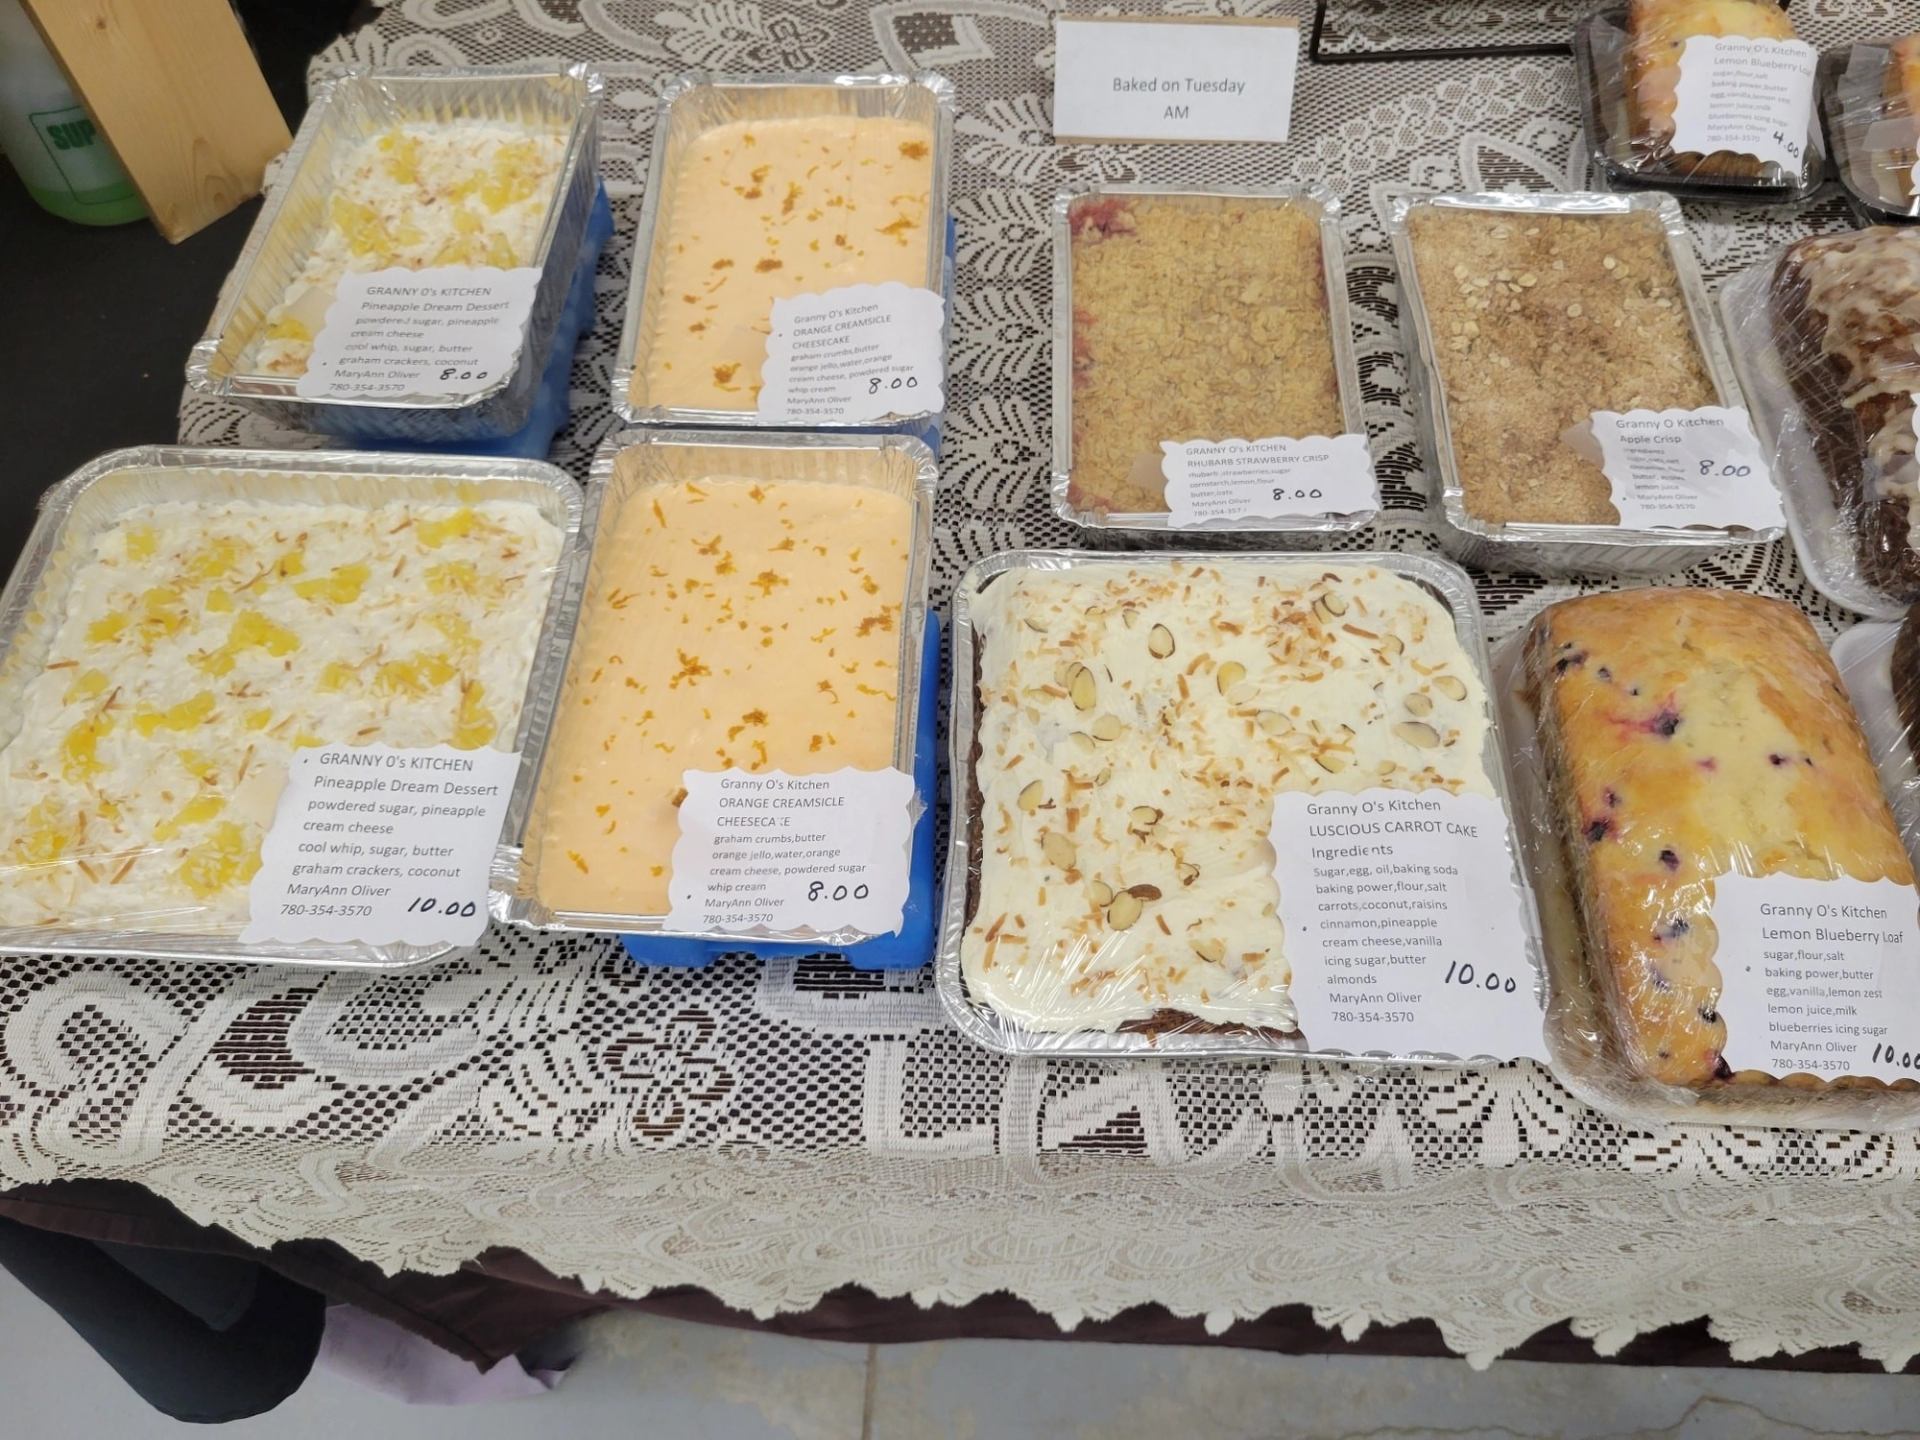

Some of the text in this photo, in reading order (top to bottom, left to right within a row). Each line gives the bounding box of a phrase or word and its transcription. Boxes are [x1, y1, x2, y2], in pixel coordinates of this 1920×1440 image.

[1715, 43, 1751, 53] Granny
[1772, 46, 1806, 58] Kitchen
[1714, 57, 1748, 65] Lemon
[1751, 59, 1796, 73] Blueberry
[1113, 77, 1245, 95] Baked on Tuesday
[1164, 106, 1189, 119] AM
[1773, 131, 1799, 158] 4.00
[367, 286, 419, 296] GRANNY
[441, 288, 492, 296] KITCHEN
[362, 301, 509, 312] Pineapple Dream Dessert
[794, 311, 826, 324] Granny
[845, 304, 878, 316] Kitchen
[447, 317, 499, 326] pineapple
[793, 315, 891, 336] ORANGE CREAMSICLE
[792, 336, 850, 350] CHEESECAKE
[339, 357, 479, 366] graham crackers, coconut
[791, 352, 822, 362] graham
[335, 370, 420, 379] MaryAnn Oliver
[440, 368, 487, 380] 8.00
[789, 374, 814, 382] cream
[849, 366, 889, 380] powdered
[891, 365, 914, 374] sugar
[790, 364, 818, 373] orange
[329, 383, 405, 391] 780-354-3570
[788, 384, 809, 394] whip
[869, 377, 917, 394] 8.00
[787, 397, 825, 405] MaryAnn
[1616, 419, 1659, 429] Granny
[1678, 417, 1724, 428] Kitchen
[1620, 435, 1682, 444] Apple Crisp
[1186, 447, 1225, 455] GRANNY
[1246, 444, 1286, 452] KITCHEN
[1188, 458, 1233, 468] RHUBARB
[1236, 456, 1300, 465] STRAWBERRY
[1700, 460, 1750, 477] 8.00
[1273, 488, 1322, 500] 8.00
[1194, 508, 1246, 516] 780-354-357
[320, 753, 382, 766] GRANNY
[410, 757, 473, 771] KITCHEN
[314, 776, 498, 796] Pineapple Dream Dessert
[721, 779, 830, 792] Granny O's Kitchen
[308, 800, 486, 818] powdered sugar, pineapple
[720, 797, 845, 809] ORANGE CREAMSICLE
[1307, 800, 1441, 816] Granny O's Kitchen
[303, 821, 394, 834] cream cheese
[717, 816, 791, 827] CHEESECAE
[1309, 821, 1478, 838] LUSCIOUS CARROT CAKE
[714, 835, 752, 845] graham
[298, 842, 454, 857] cool whip, sugar, butter
[712, 851, 748, 860] orange
[292, 864, 461, 878] graham crackers, coconut
[710, 864, 866, 876] cream cheese, powdered sugar
[1433, 865, 1458, 876] soda
[287, 884, 391, 898] MaryAnn Oliver
[708, 883, 766, 893] whip cream
[808, 881, 869, 901] 8.00
[1316, 883, 1354, 895] baking
[407, 897, 476, 917] 10.00
[705, 898, 784, 909] MaryAnn Oliver
[280, 904, 372, 917] 780-354-3570
[1760, 903, 1888, 919] Granny O's Kitchen
[703, 914, 774, 924] 780-354-3570
[1322, 936, 1442, 947] cream cheese,vanilla
[1762, 927, 1903, 944] Lemon Blueberry Loaf
[1324, 955, 1426, 968] icing sugar,butter
[1764, 950, 1845, 962] sugar,flour,salt
[1327, 974, 1377, 985] almonds
[1445, 960, 1516, 993] 10.00
[1765, 967, 1873, 980] baking power,butter
[1330, 992, 1422, 1004] MaryAnn Oliver
[1864, 990, 1883, 999] zest
[1768, 1004, 1858, 1016] lemon juice,milk
[1332, 1011, 1414, 1023] 780-354-3570
[1769, 1022, 1888, 1036] blueberries icing sugar
[1770, 1040, 1858, 1053] MaryAnn Oliver
[1771, 1058, 1850, 1071] 780-354-3570
